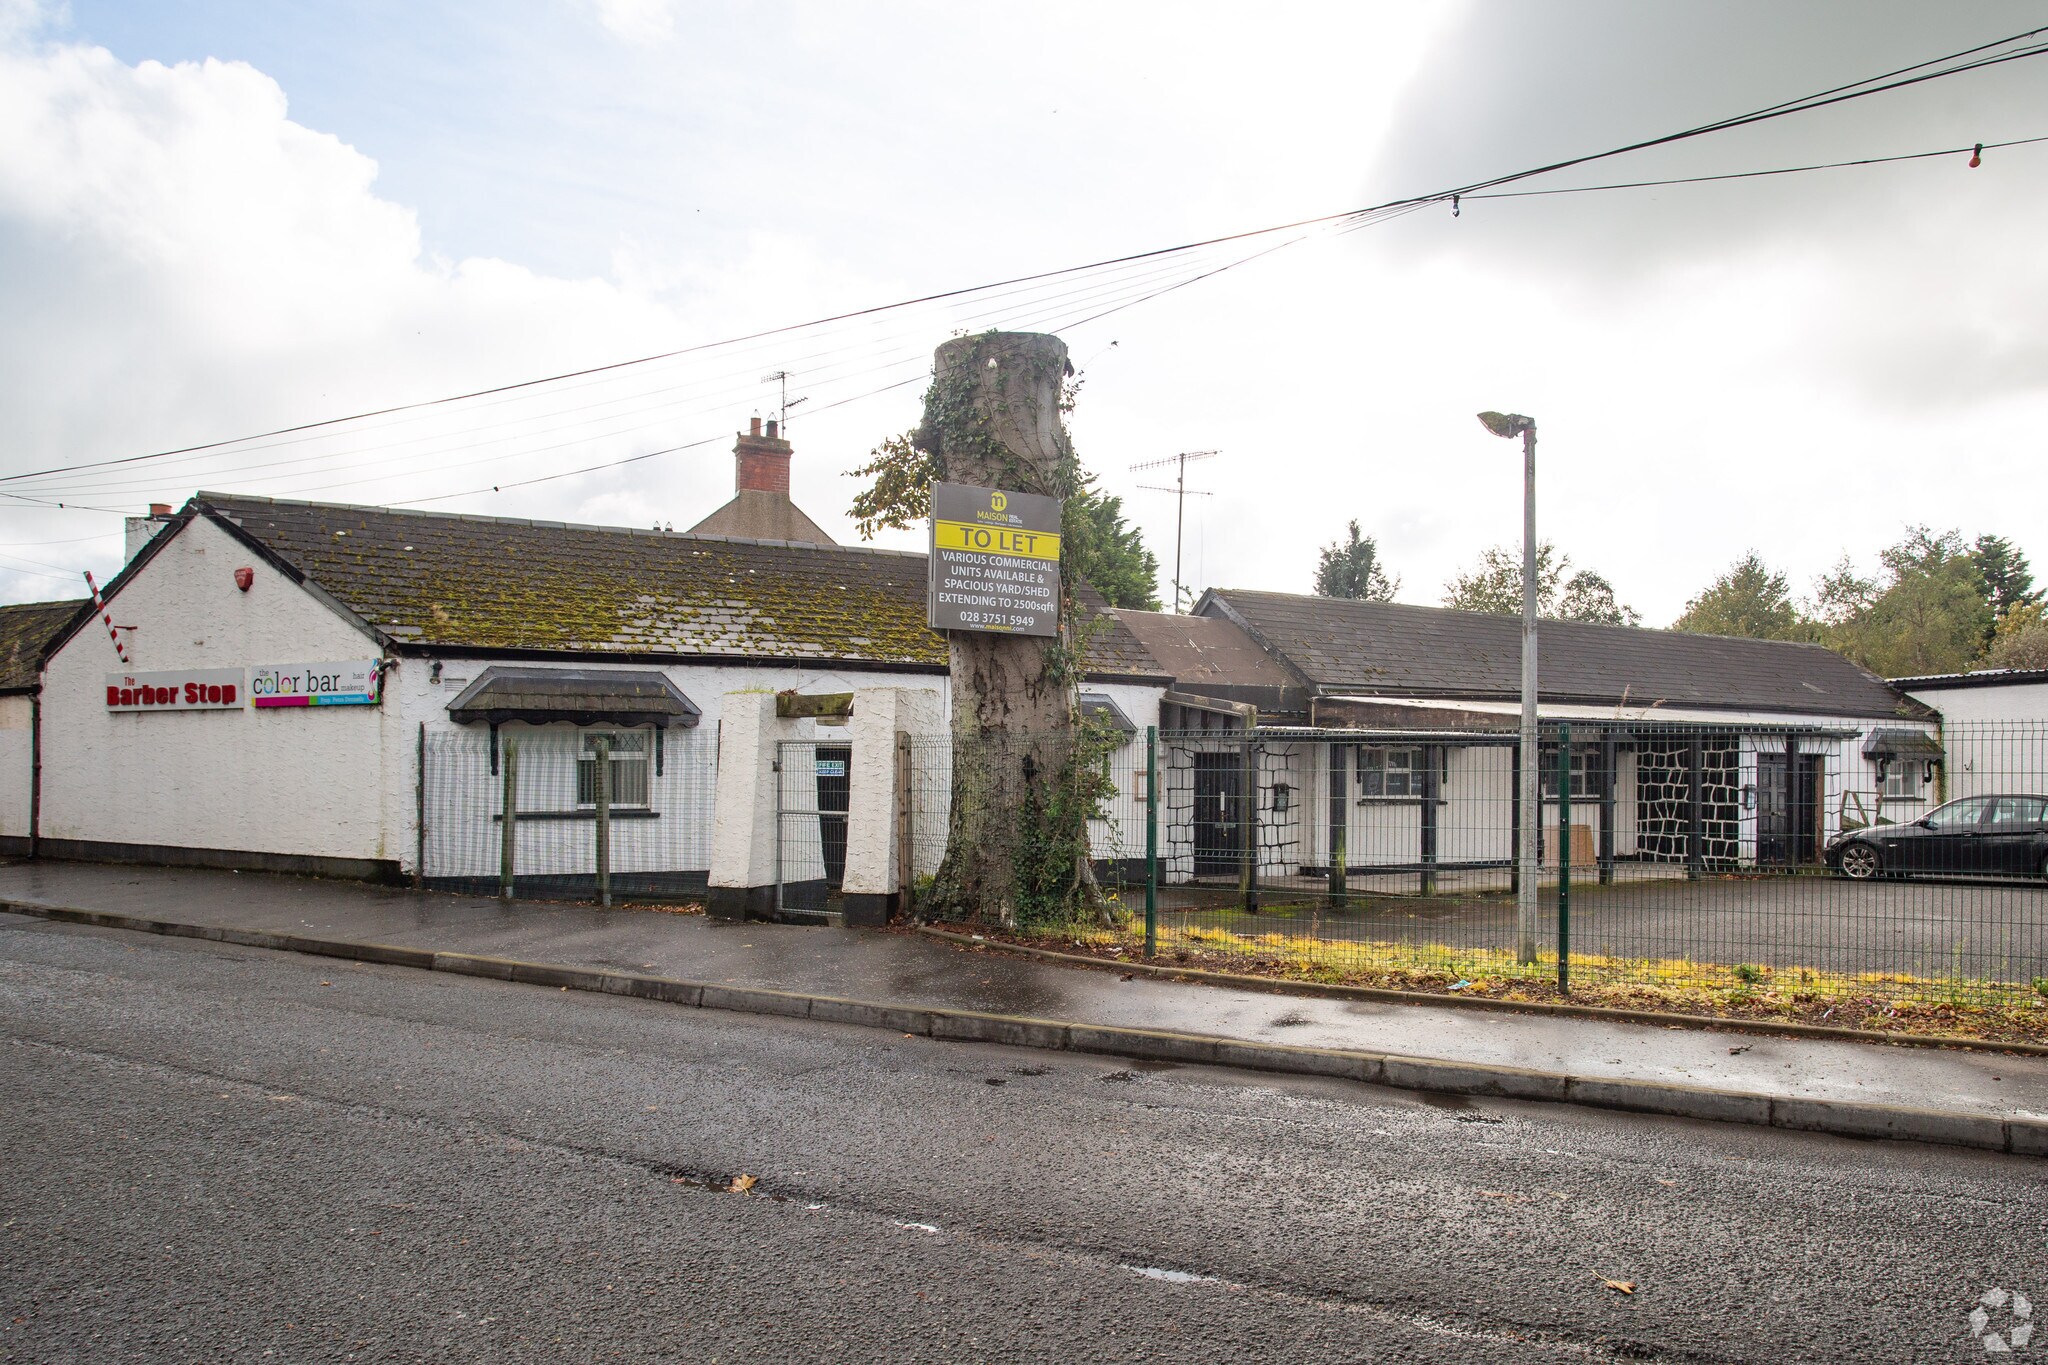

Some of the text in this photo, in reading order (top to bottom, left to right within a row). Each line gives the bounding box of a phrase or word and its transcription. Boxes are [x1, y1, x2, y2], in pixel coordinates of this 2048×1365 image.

[977, 511, 1008, 522] MAISON
[960, 527, 1038, 553] TO LET
[942, 551, 1053, 572] VARIOUS COMMERCIAL
[951, 565, 1044, 584] UNITS AVAILABLE &
[944, 578, 1050, 597] SPACIOUS YARD/SHED
[939, 592, 1054, 613] EXTENDING TO 2500sqft
[960, 611, 1034, 627] 028 3751 5949
[970, 622, 1025, 632] www.maisonni.com
[124, 677, 135, 686] The
[253, 670, 340, 694] color bar
[341, 684, 365, 693] makeup
[107, 682, 236, 706] Barber Stop
